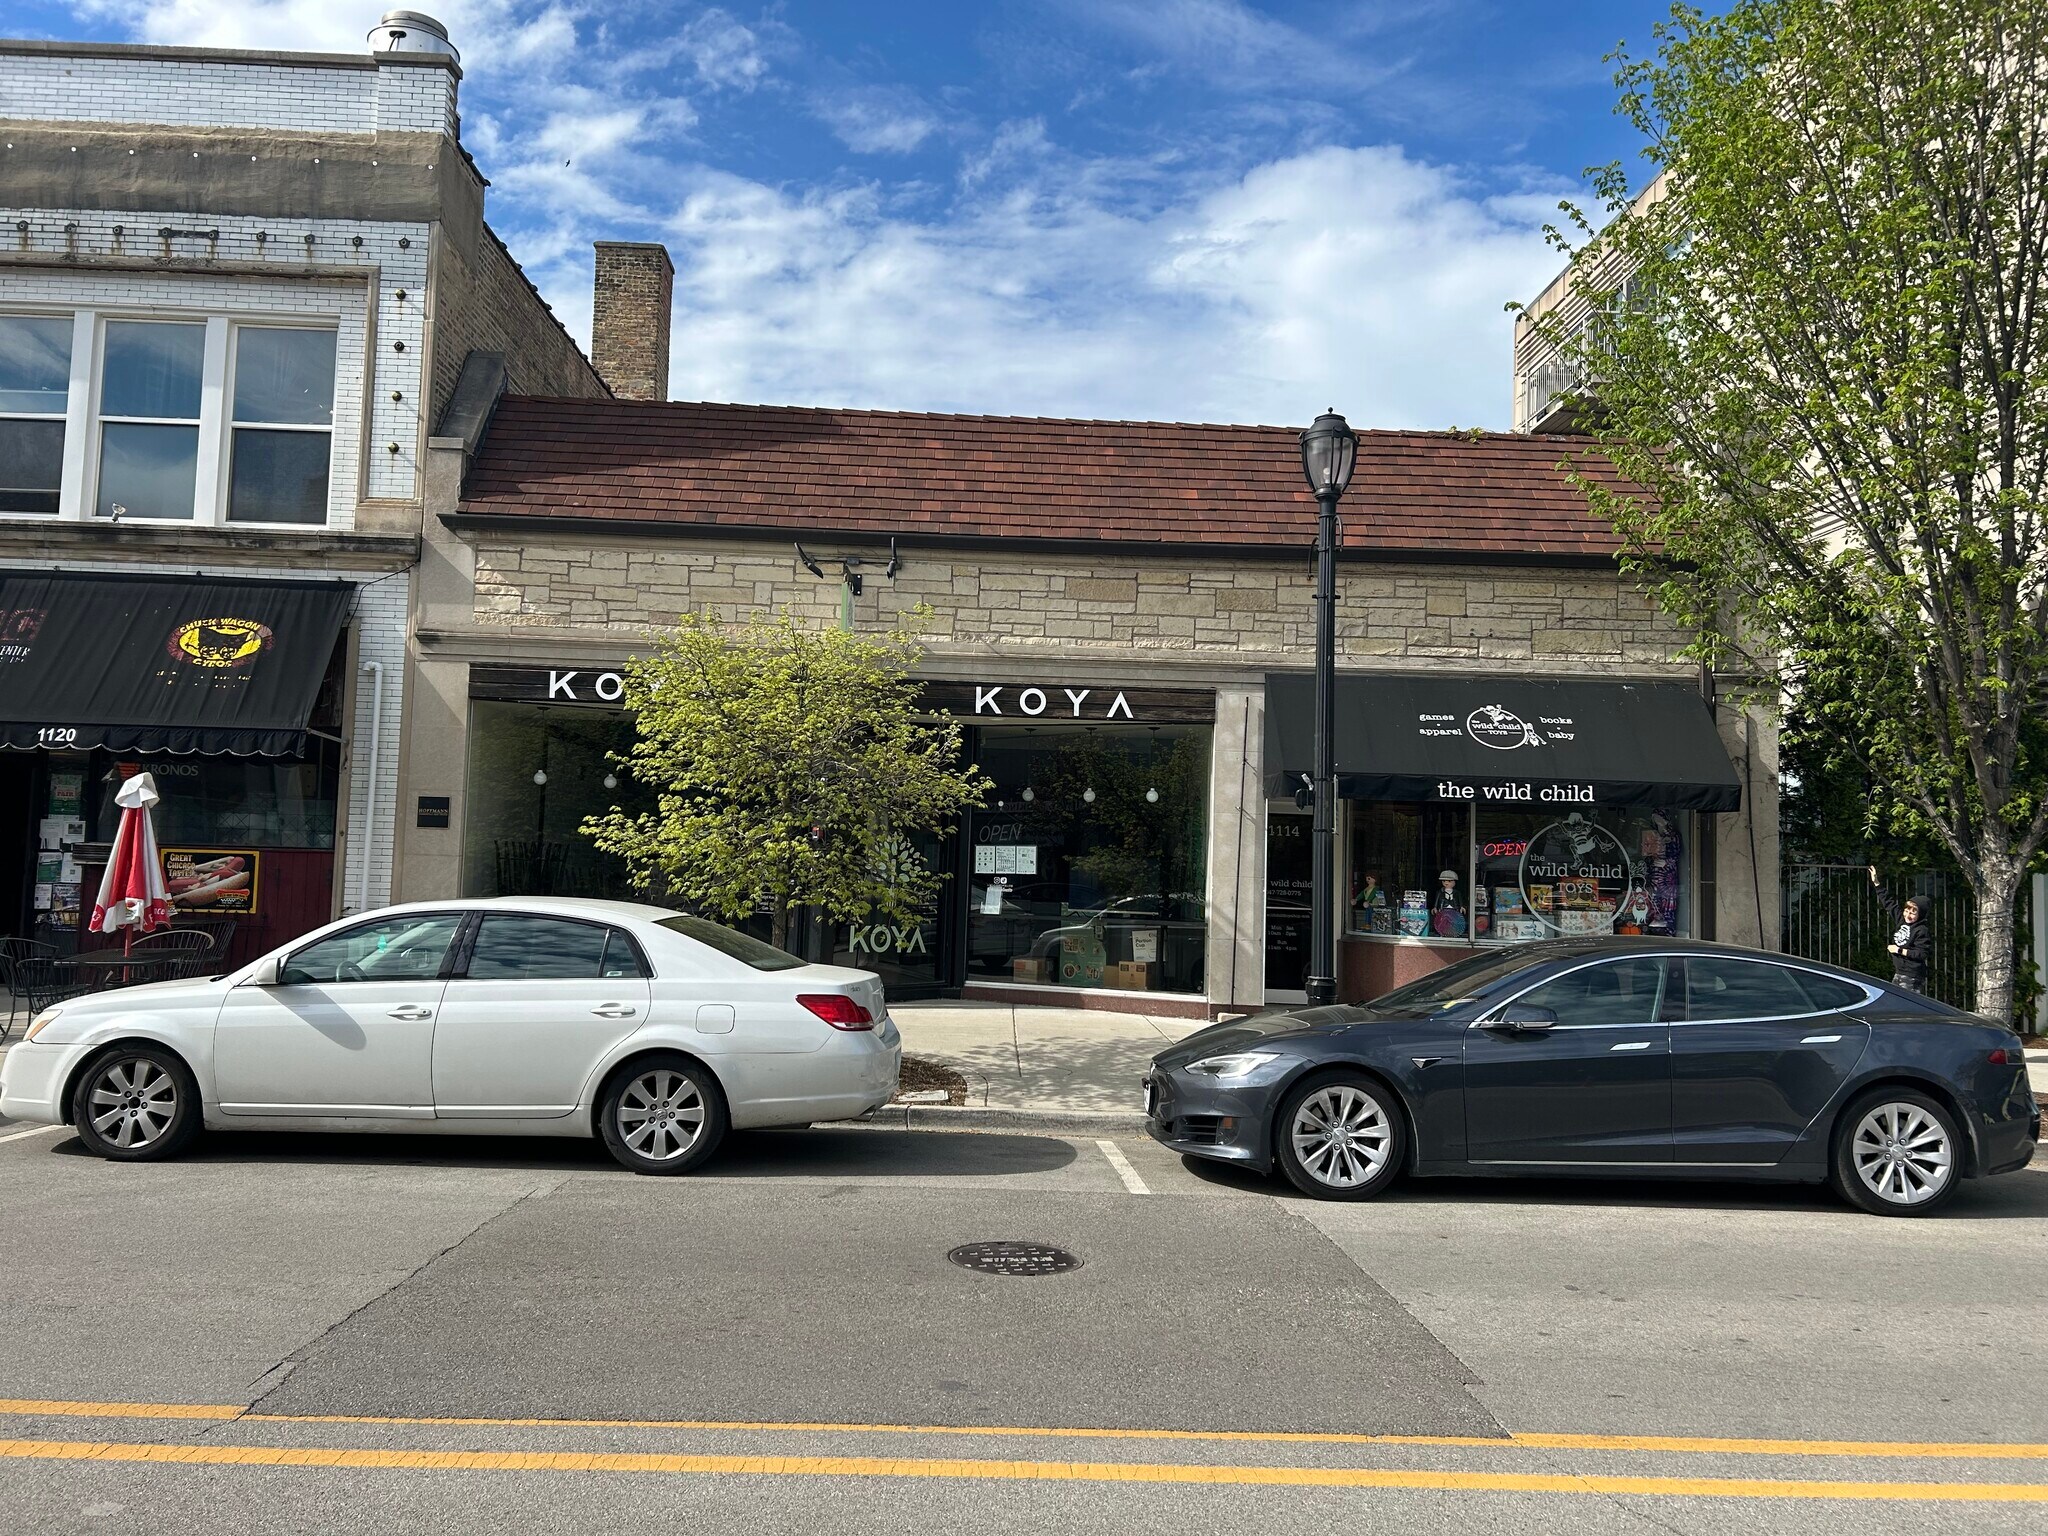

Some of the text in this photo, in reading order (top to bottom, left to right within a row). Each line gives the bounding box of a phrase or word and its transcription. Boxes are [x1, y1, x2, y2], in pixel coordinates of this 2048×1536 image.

[220, 617, 260, 631] WAGON
[975, 686, 1134, 719] KOYA
[1419, 714, 1455, 722] games
[1539, 716, 1573, 725] books
[1419, 728, 1463, 736] apparel
[1471, 722, 1522, 731] wild child
[37, 727, 77, 742] 1120
[1547, 731, 1575, 740] baby
[142, 763, 199, 777] KRONOS
[1437, 781, 1594, 803] the wild child
[979, 823, 1022, 842] OPEN
[1268, 825, 1300, 837] 1114
[1483, 843, 1527, 857] OPEN
[170, 853, 193, 862] GREAT
[1530, 853, 1546, 862] the
[167, 861, 196, 870] CHICAGO
[1529, 863, 1623, 879] wild child
[1270, 880, 1313, 888] wild child
[1556, 882, 1593, 894] TOYS
[849, 924, 927, 954] KOYA
